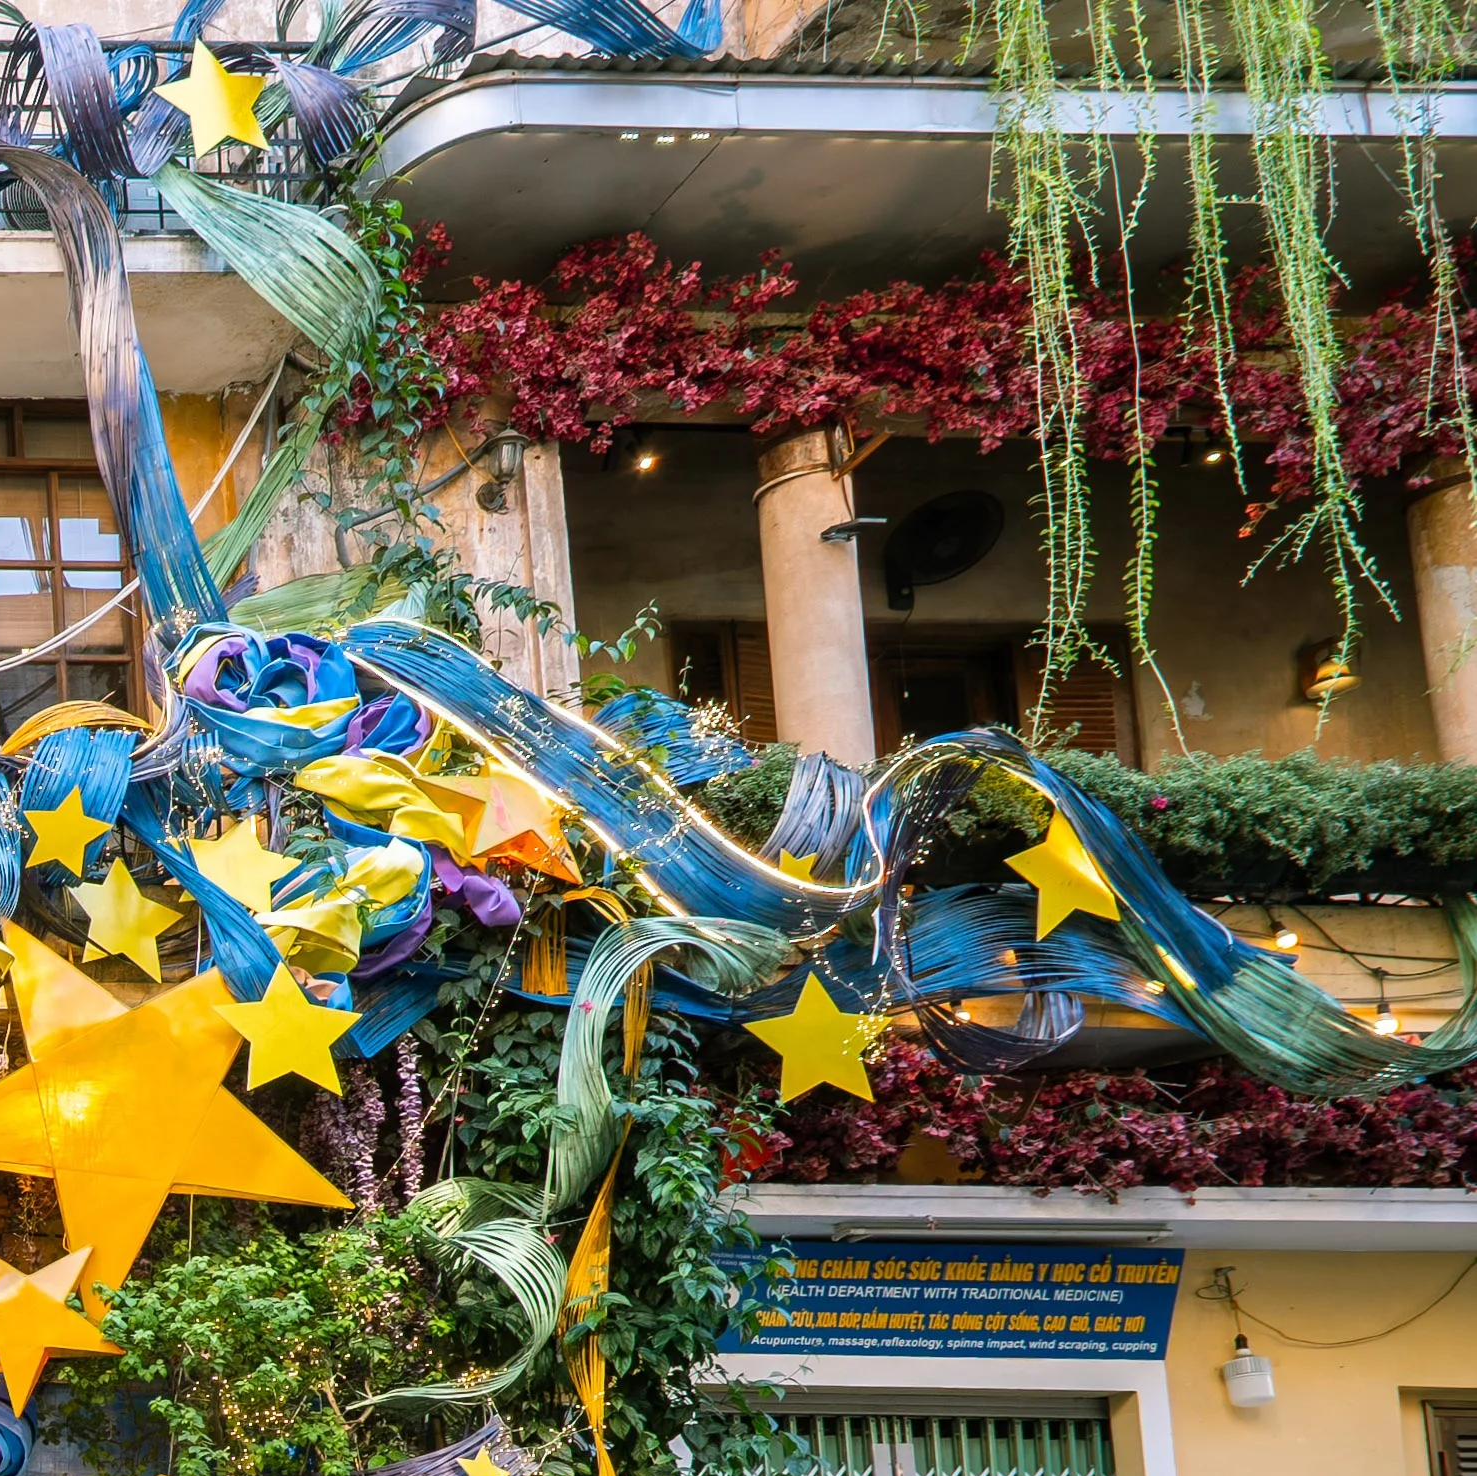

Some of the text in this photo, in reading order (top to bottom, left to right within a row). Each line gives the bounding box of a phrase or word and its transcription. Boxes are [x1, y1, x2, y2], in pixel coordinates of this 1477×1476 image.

[873, 1256, 908, 1281] SÓC
[908, 1255, 942, 1281] SỨC
[1037, 1262, 1051, 1283] Y
[1051, 1263, 1086, 1287] HỌC
[828, 1285, 921, 1299] DEPARTMENT
[923, 1287, 958, 1300] WITH
[960, 1287, 1052, 1301] TRADITIONAL
[1053, 1289, 1124, 1304] MEDICINE)
[928, 1309, 949, 1330] TÁC
[751, 1335, 825, 1348] Acupuncture,
[947, 1338, 984, 1350] spinne
[986, 1338, 1026, 1350] impact,
[1028, 1339, 1056, 1350] wind
[1057, 1340, 1108, 1352] scraping,
[1112, 1341, 1157, 1353] cupping
